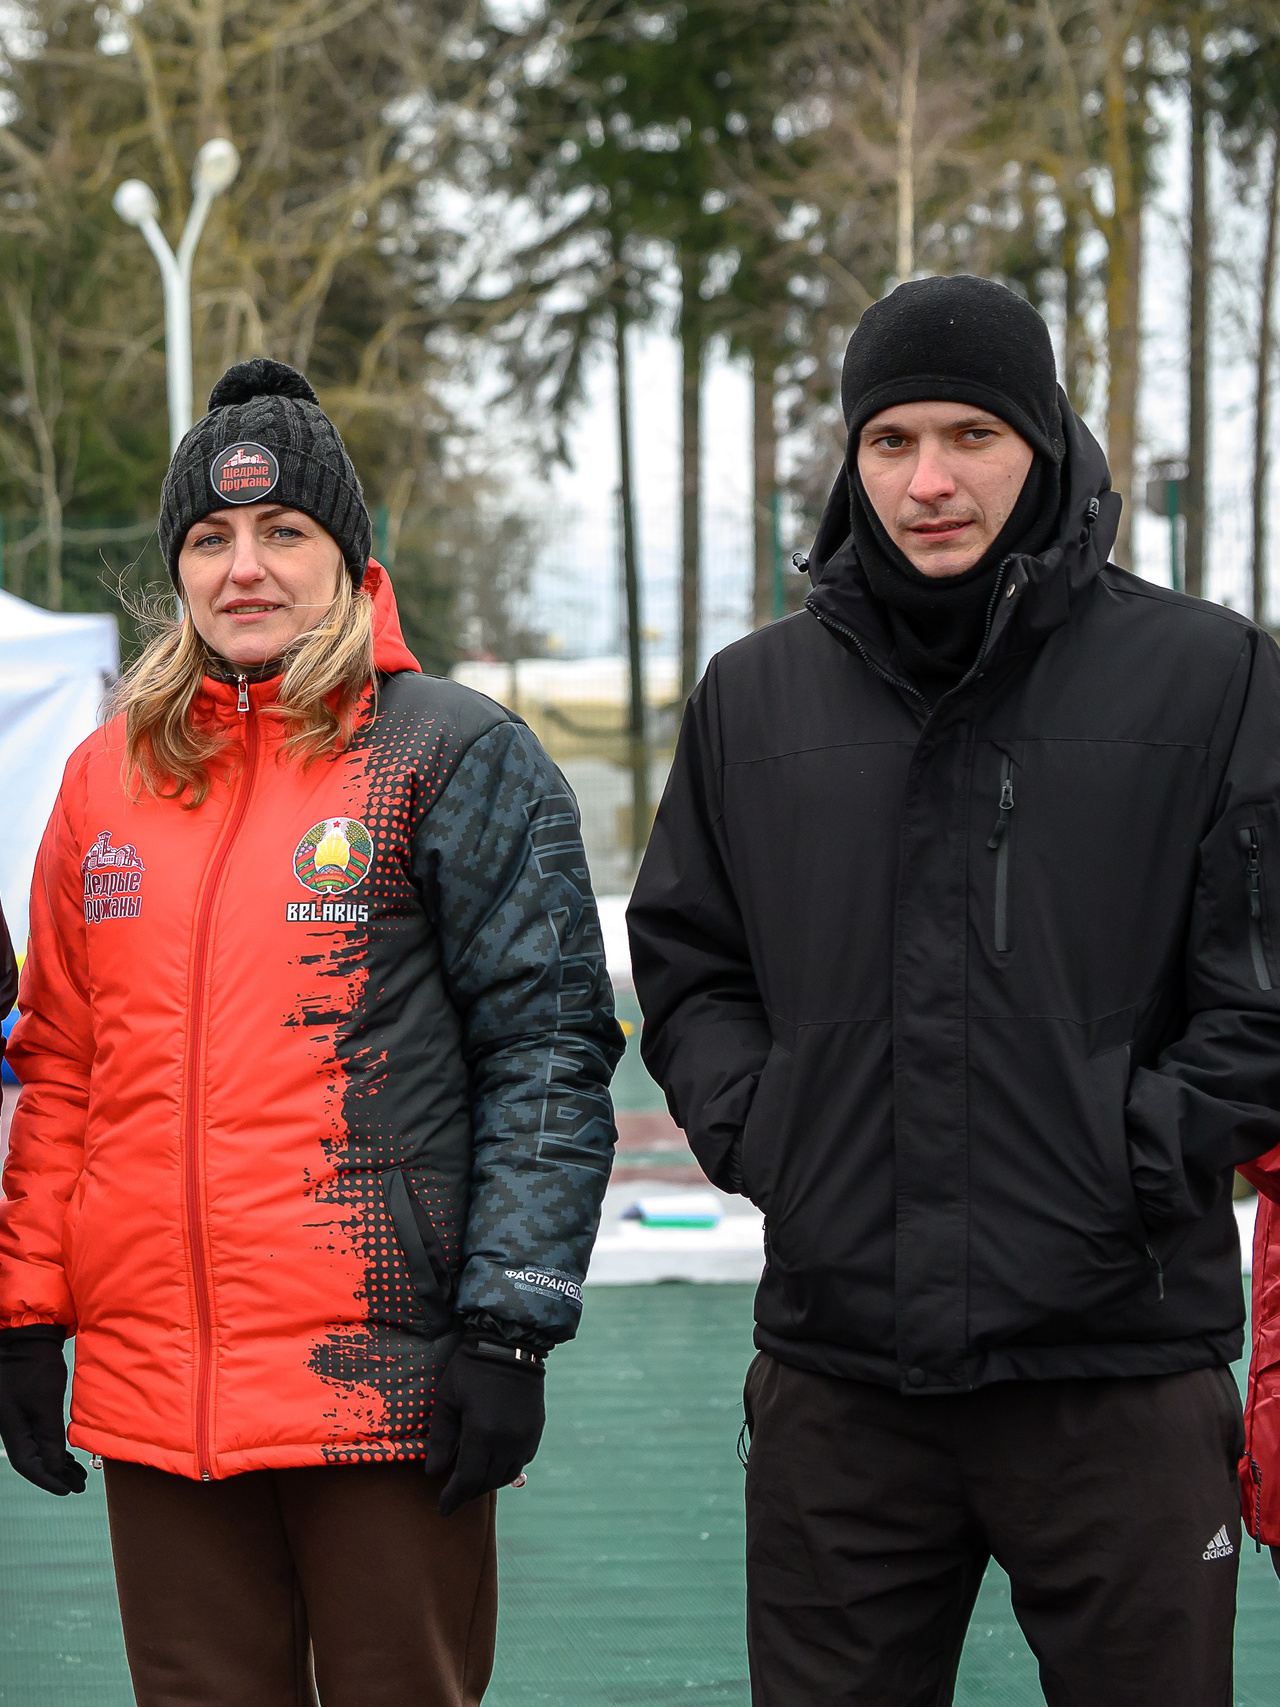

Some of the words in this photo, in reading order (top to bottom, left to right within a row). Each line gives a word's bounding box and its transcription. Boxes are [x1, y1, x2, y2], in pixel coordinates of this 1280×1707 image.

[222, 465, 269, 479] Щедрые
[220, 477, 271, 492] Пружаны
[286, 903, 369, 922] BELARUS
[504, 1270, 566, 1293] ФАСТРАН
[1202, 1545, 1234, 1560] adidas
